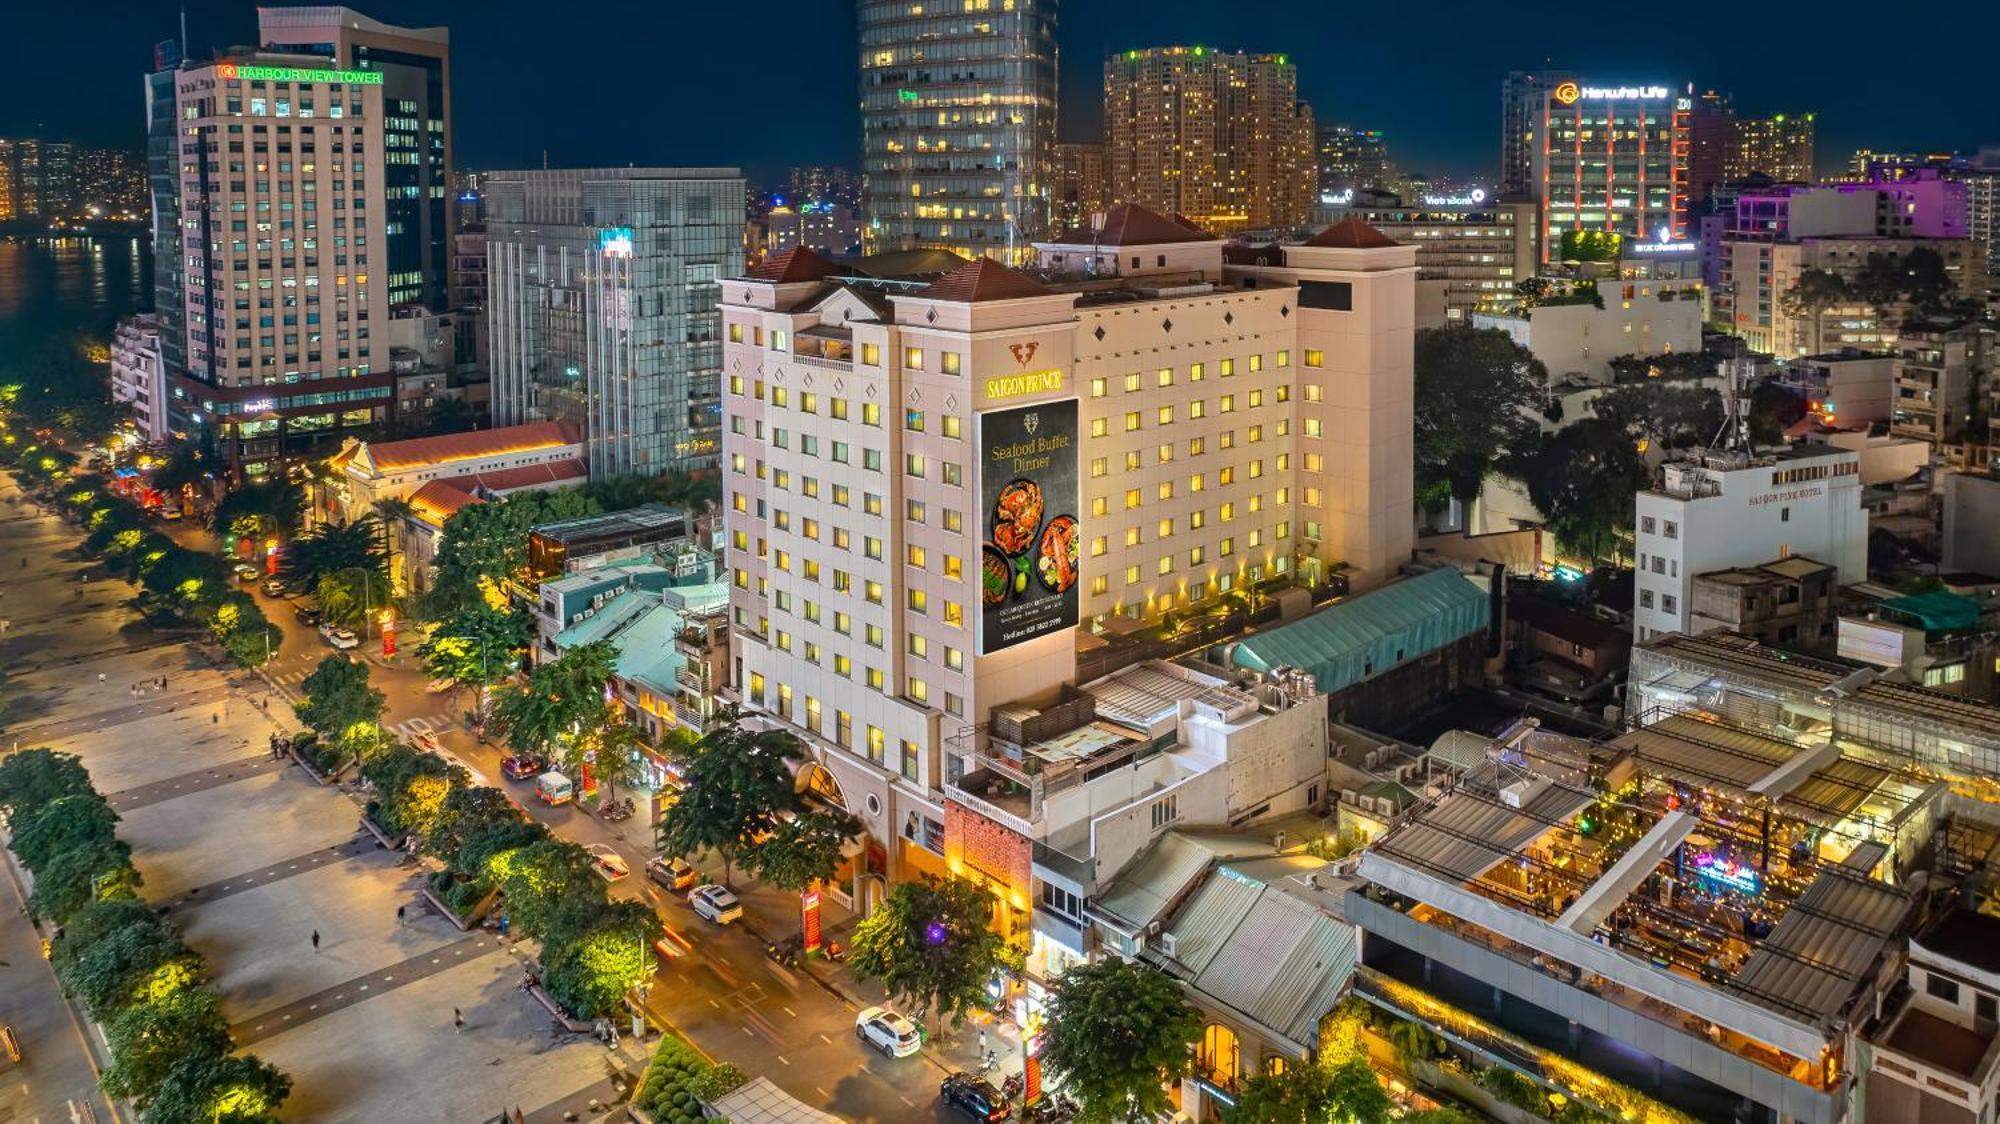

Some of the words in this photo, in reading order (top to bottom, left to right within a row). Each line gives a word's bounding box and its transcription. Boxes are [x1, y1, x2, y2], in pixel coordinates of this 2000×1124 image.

[238, 67, 300, 80] HARBOUR
[303, 68, 334, 82] VIEW
[338, 71, 381, 83] TOWER
[1581, 86, 1639, 99] Hanwha
[1639, 86, 1668, 98] Life
[987, 377, 1025, 399] SAIGON
[1026, 371, 1062, 393] PRINCE
[991, 439, 1035, 461] Seafood
[1038, 434, 1071, 453] Buffet
[1013, 456, 1050, 473] Dinner
[1749, 494, 1778, 505] SAIGON
[1799, 487, 1822, 498] HOTEL
